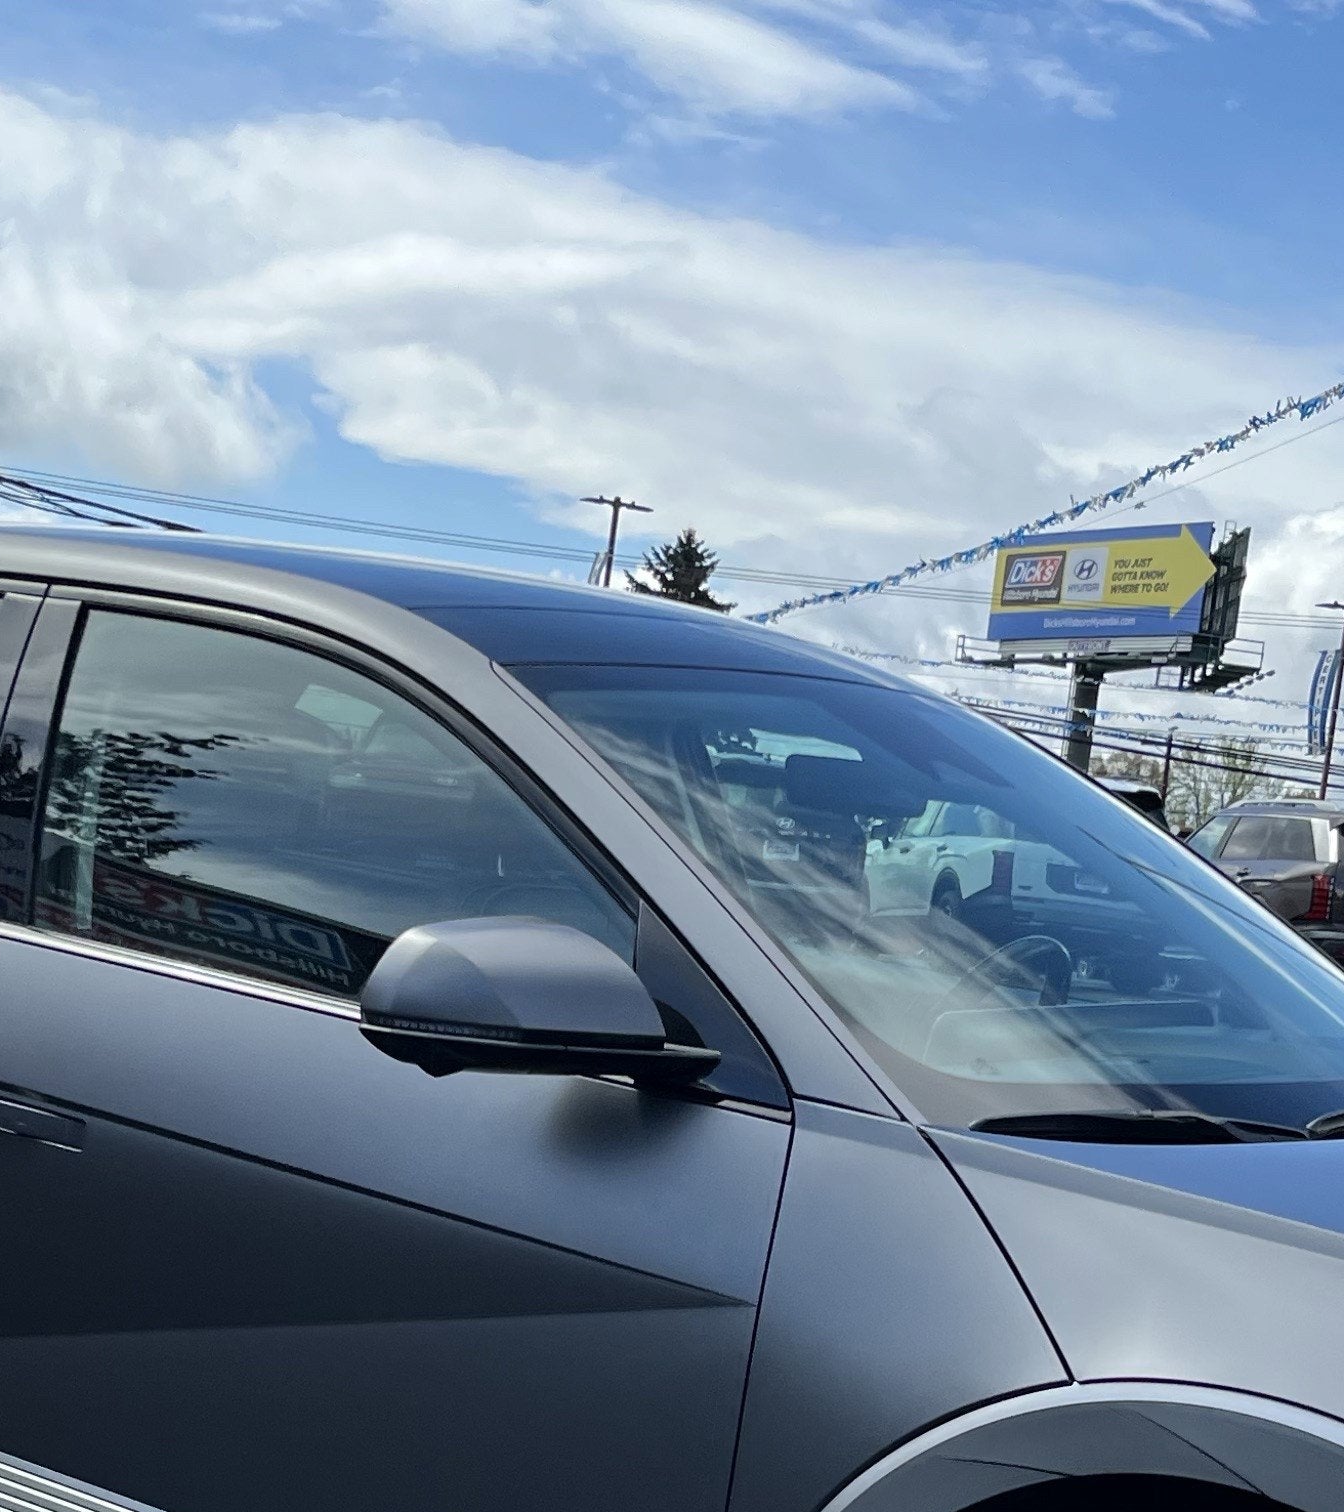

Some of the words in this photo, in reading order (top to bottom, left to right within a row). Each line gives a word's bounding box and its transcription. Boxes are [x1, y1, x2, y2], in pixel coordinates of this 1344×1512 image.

[1114, 559, 1130, 569] YOU
[1131, 557, 1153, 568] JUST
[1112, 571, 1138, 581] GOTTA
[1139, 570, 1167, 580] KNOW
[1110, 583, 1140, 594] WHERE
[1142, 583, 1153, 592] TO
[1154, 582, 1170, 592] GO!
